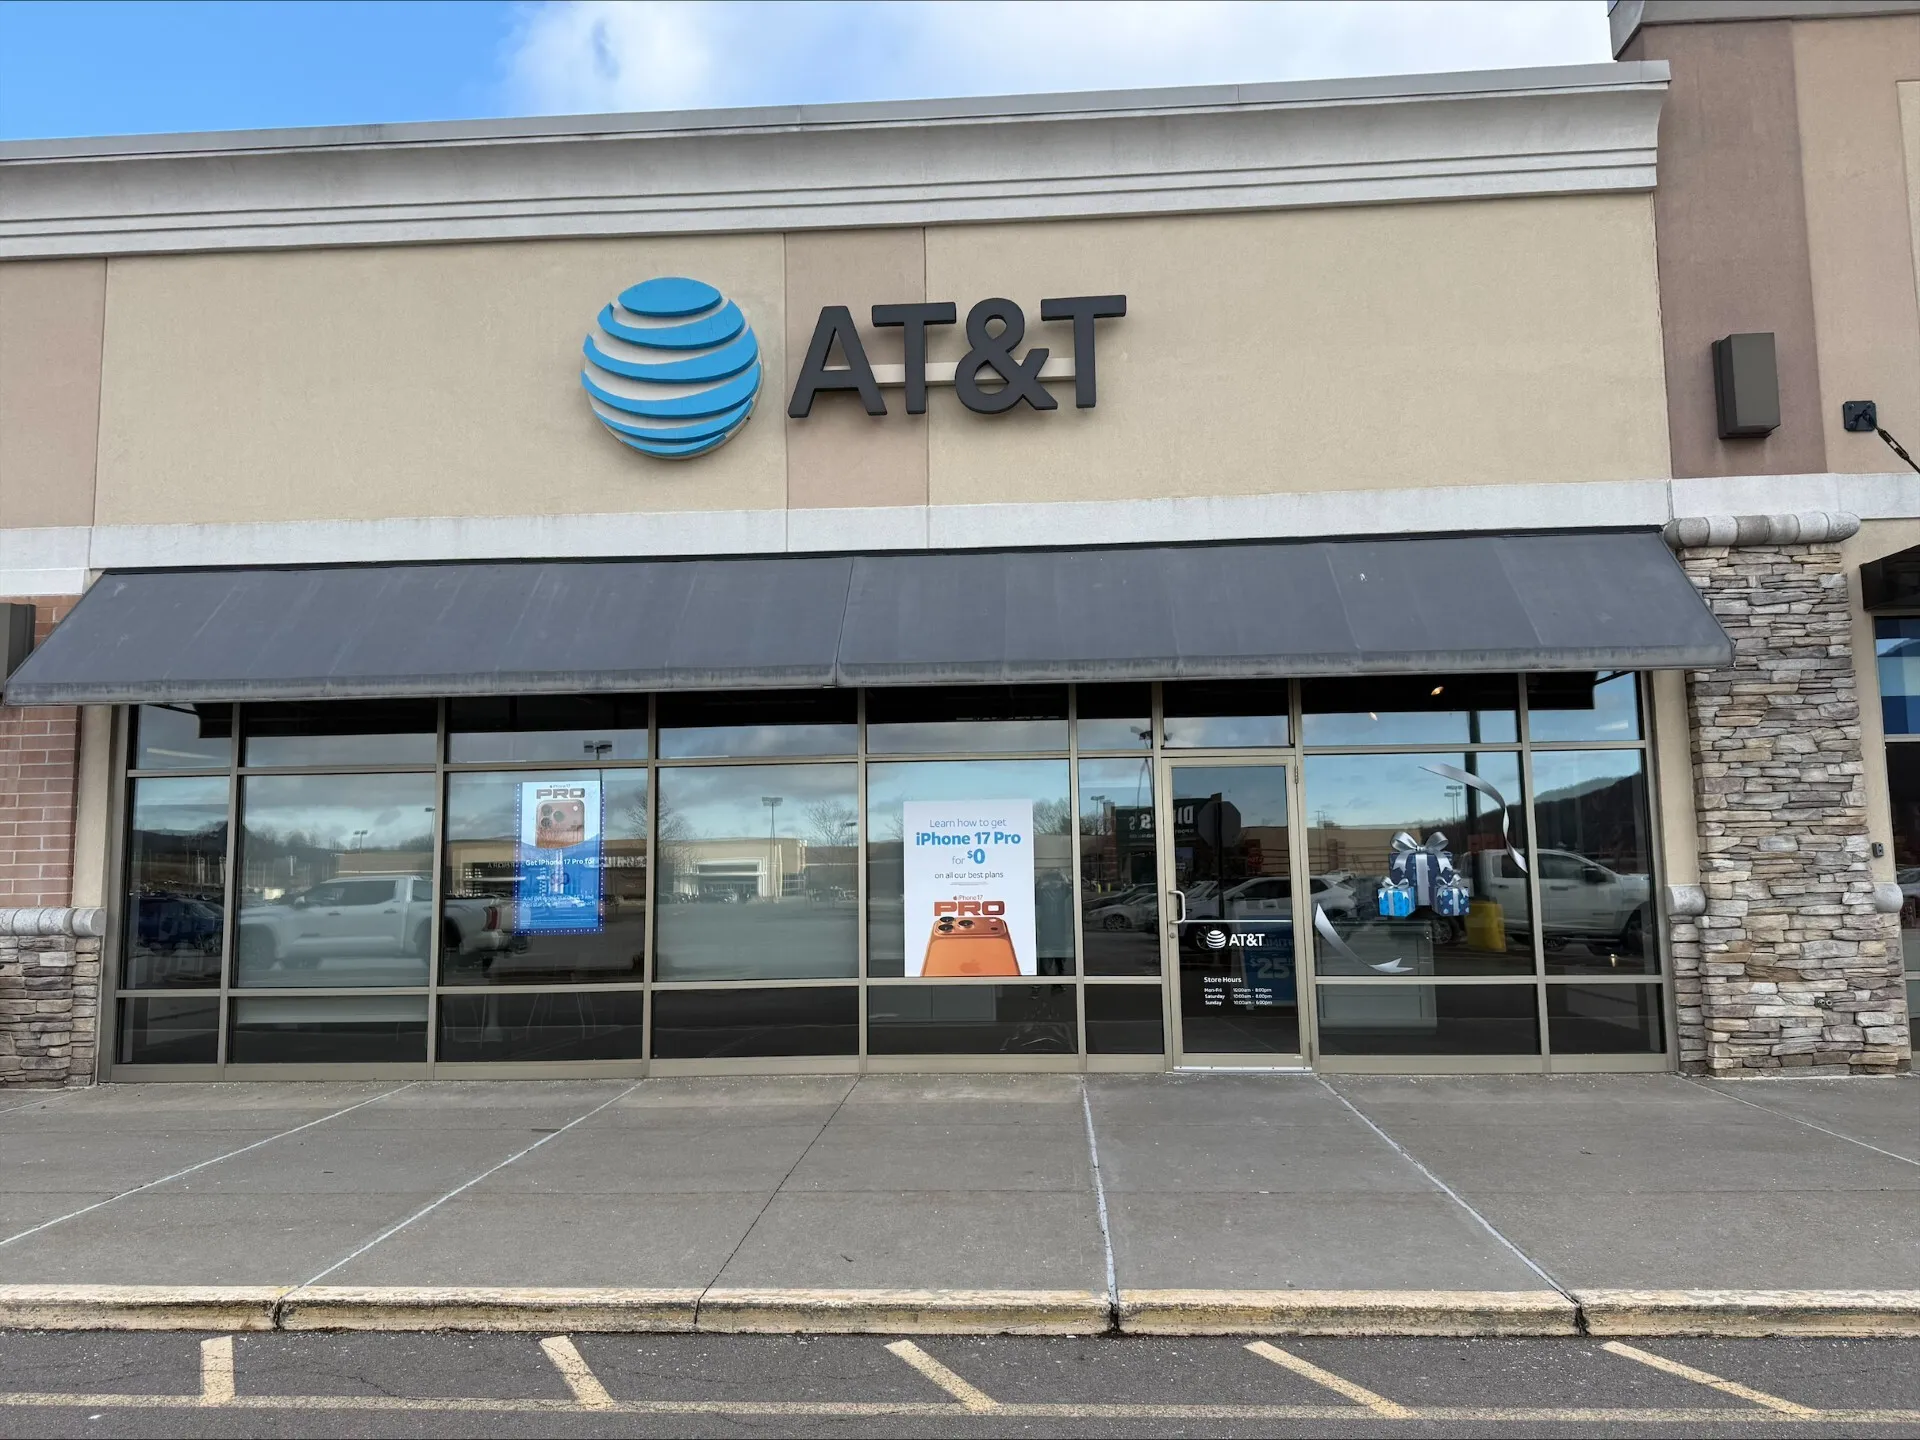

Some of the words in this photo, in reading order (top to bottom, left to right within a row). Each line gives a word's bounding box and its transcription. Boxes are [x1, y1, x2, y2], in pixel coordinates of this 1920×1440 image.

[787, 294, 1127, 418] AT&T
[536, 788, 585, 799] PRO
[929, 819, 955, 828] Learn
[957, 818, 977, 827] how
[979, 819, 989, 827] to
[991, 818, 1007, 829] get
[916, 832, 970, 846] iPhone
[974, 831, 991, 845] 17
[994, 831, 1022, 845] Pro
[951, 856, 966, 865] for
[967, 848, 986, 865] $0
[945, 871, 953, 879] all
[967, 871, 984, 879] best
[984, 870, 1004, 880] plans
[934, 900, 1005, 917] PRO
[1229, 933, 1266, 947] AT&T
